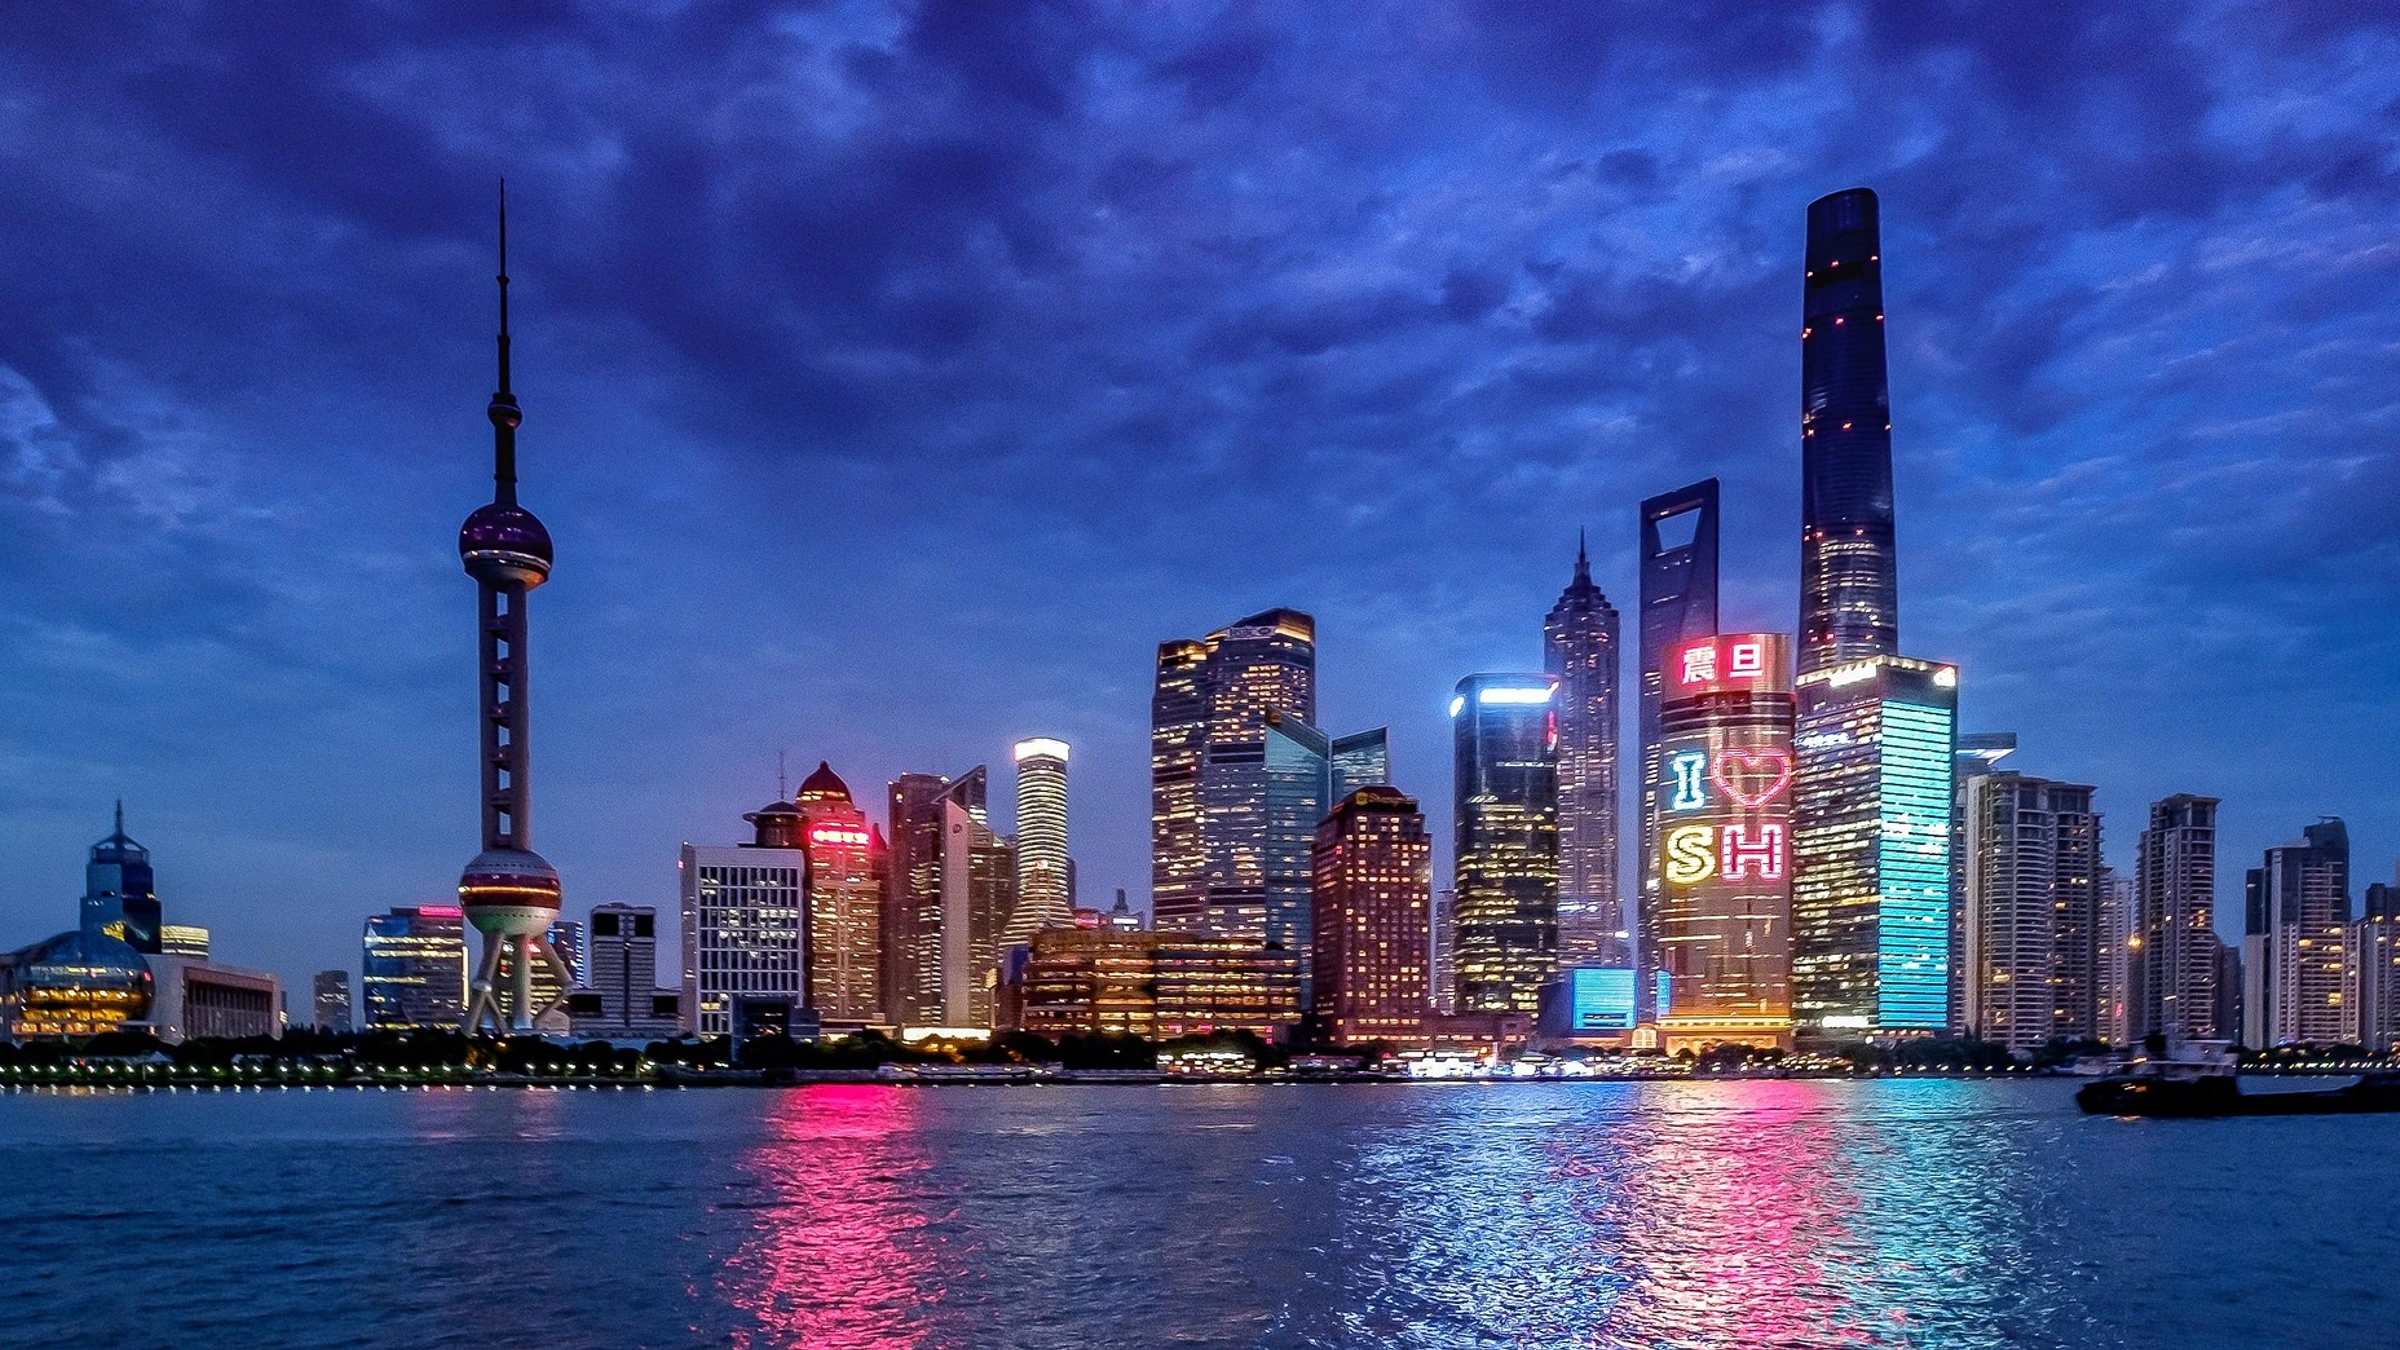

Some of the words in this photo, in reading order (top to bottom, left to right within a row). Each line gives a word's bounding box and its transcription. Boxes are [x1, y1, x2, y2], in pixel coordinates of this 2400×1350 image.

[1682, 645, 1764, 684] 震旦
[1672, 752, 1705, 810] I
[1666, 824, 1782, 882] SH
